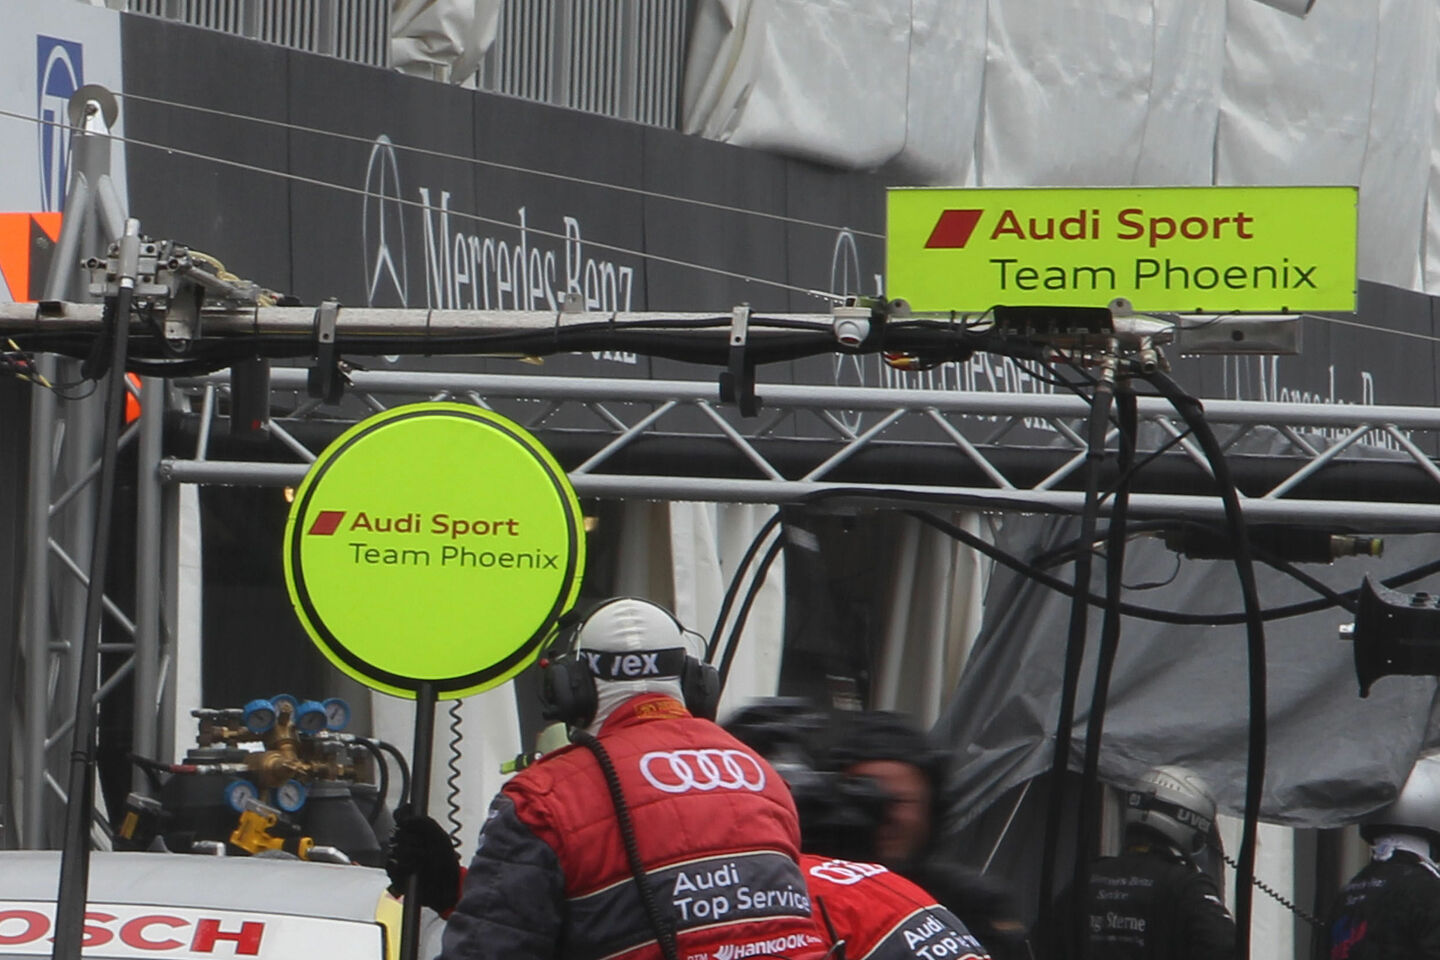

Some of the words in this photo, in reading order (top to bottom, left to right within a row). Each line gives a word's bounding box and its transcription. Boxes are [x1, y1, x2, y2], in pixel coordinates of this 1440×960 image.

[990, 208, 1101, 240] Audi
[1117, 208, 1254, 248] Sport
[990, 258, 1117, 290] Team
[1135, 258, 1318, 290] Phoenix
[349, 511, 421, 534] Audi
[431, 514, 519, 540] Sport
[348, 543, 430, 566] Team
[441, 546, 559, 570] Phoenix
[673, 862, 740, 896] Audi
[673, 896, 730, 919] Top
[903, 914, 947, 950] Audi
